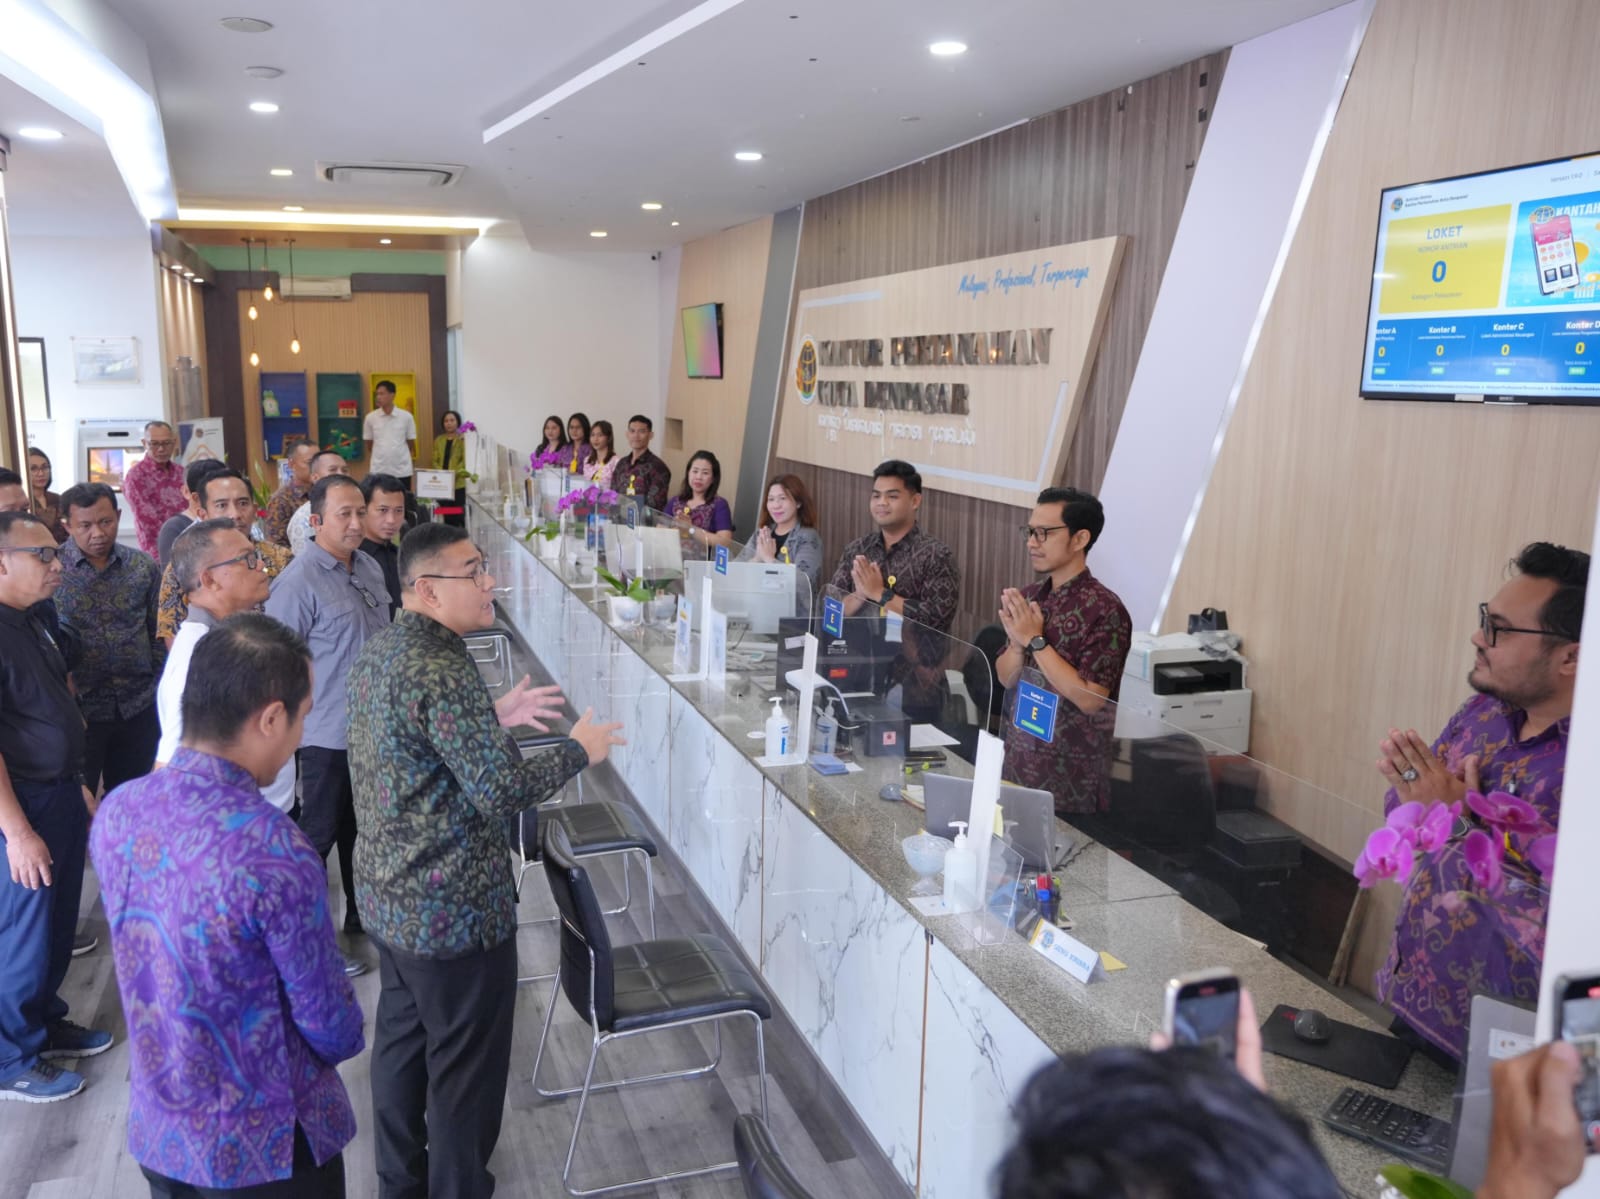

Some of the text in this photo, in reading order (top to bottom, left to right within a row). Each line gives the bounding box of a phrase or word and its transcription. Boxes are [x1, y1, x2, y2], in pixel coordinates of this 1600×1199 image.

[1427, 225, 1463, 240] LOKET
[1432, 260, 1447, 282] 0
[1428, 326, 1450, 334] Konter
[1493, 323, 1517, 331] Konter
[1566, 320, 1593, 329] Konter
[818, 328, 1053, 366] KANTOR PERTANAHAN
[1378, 346, 1386, 358] 0
[1435, 344, 1444, 357] 0
[1501, 344, 1510, 356] 0
[1575, 342, 1586, 355] 0
[818, 381, 969, 415] KOTA DENPASAR
[1031, 707, 1038, 720] E
